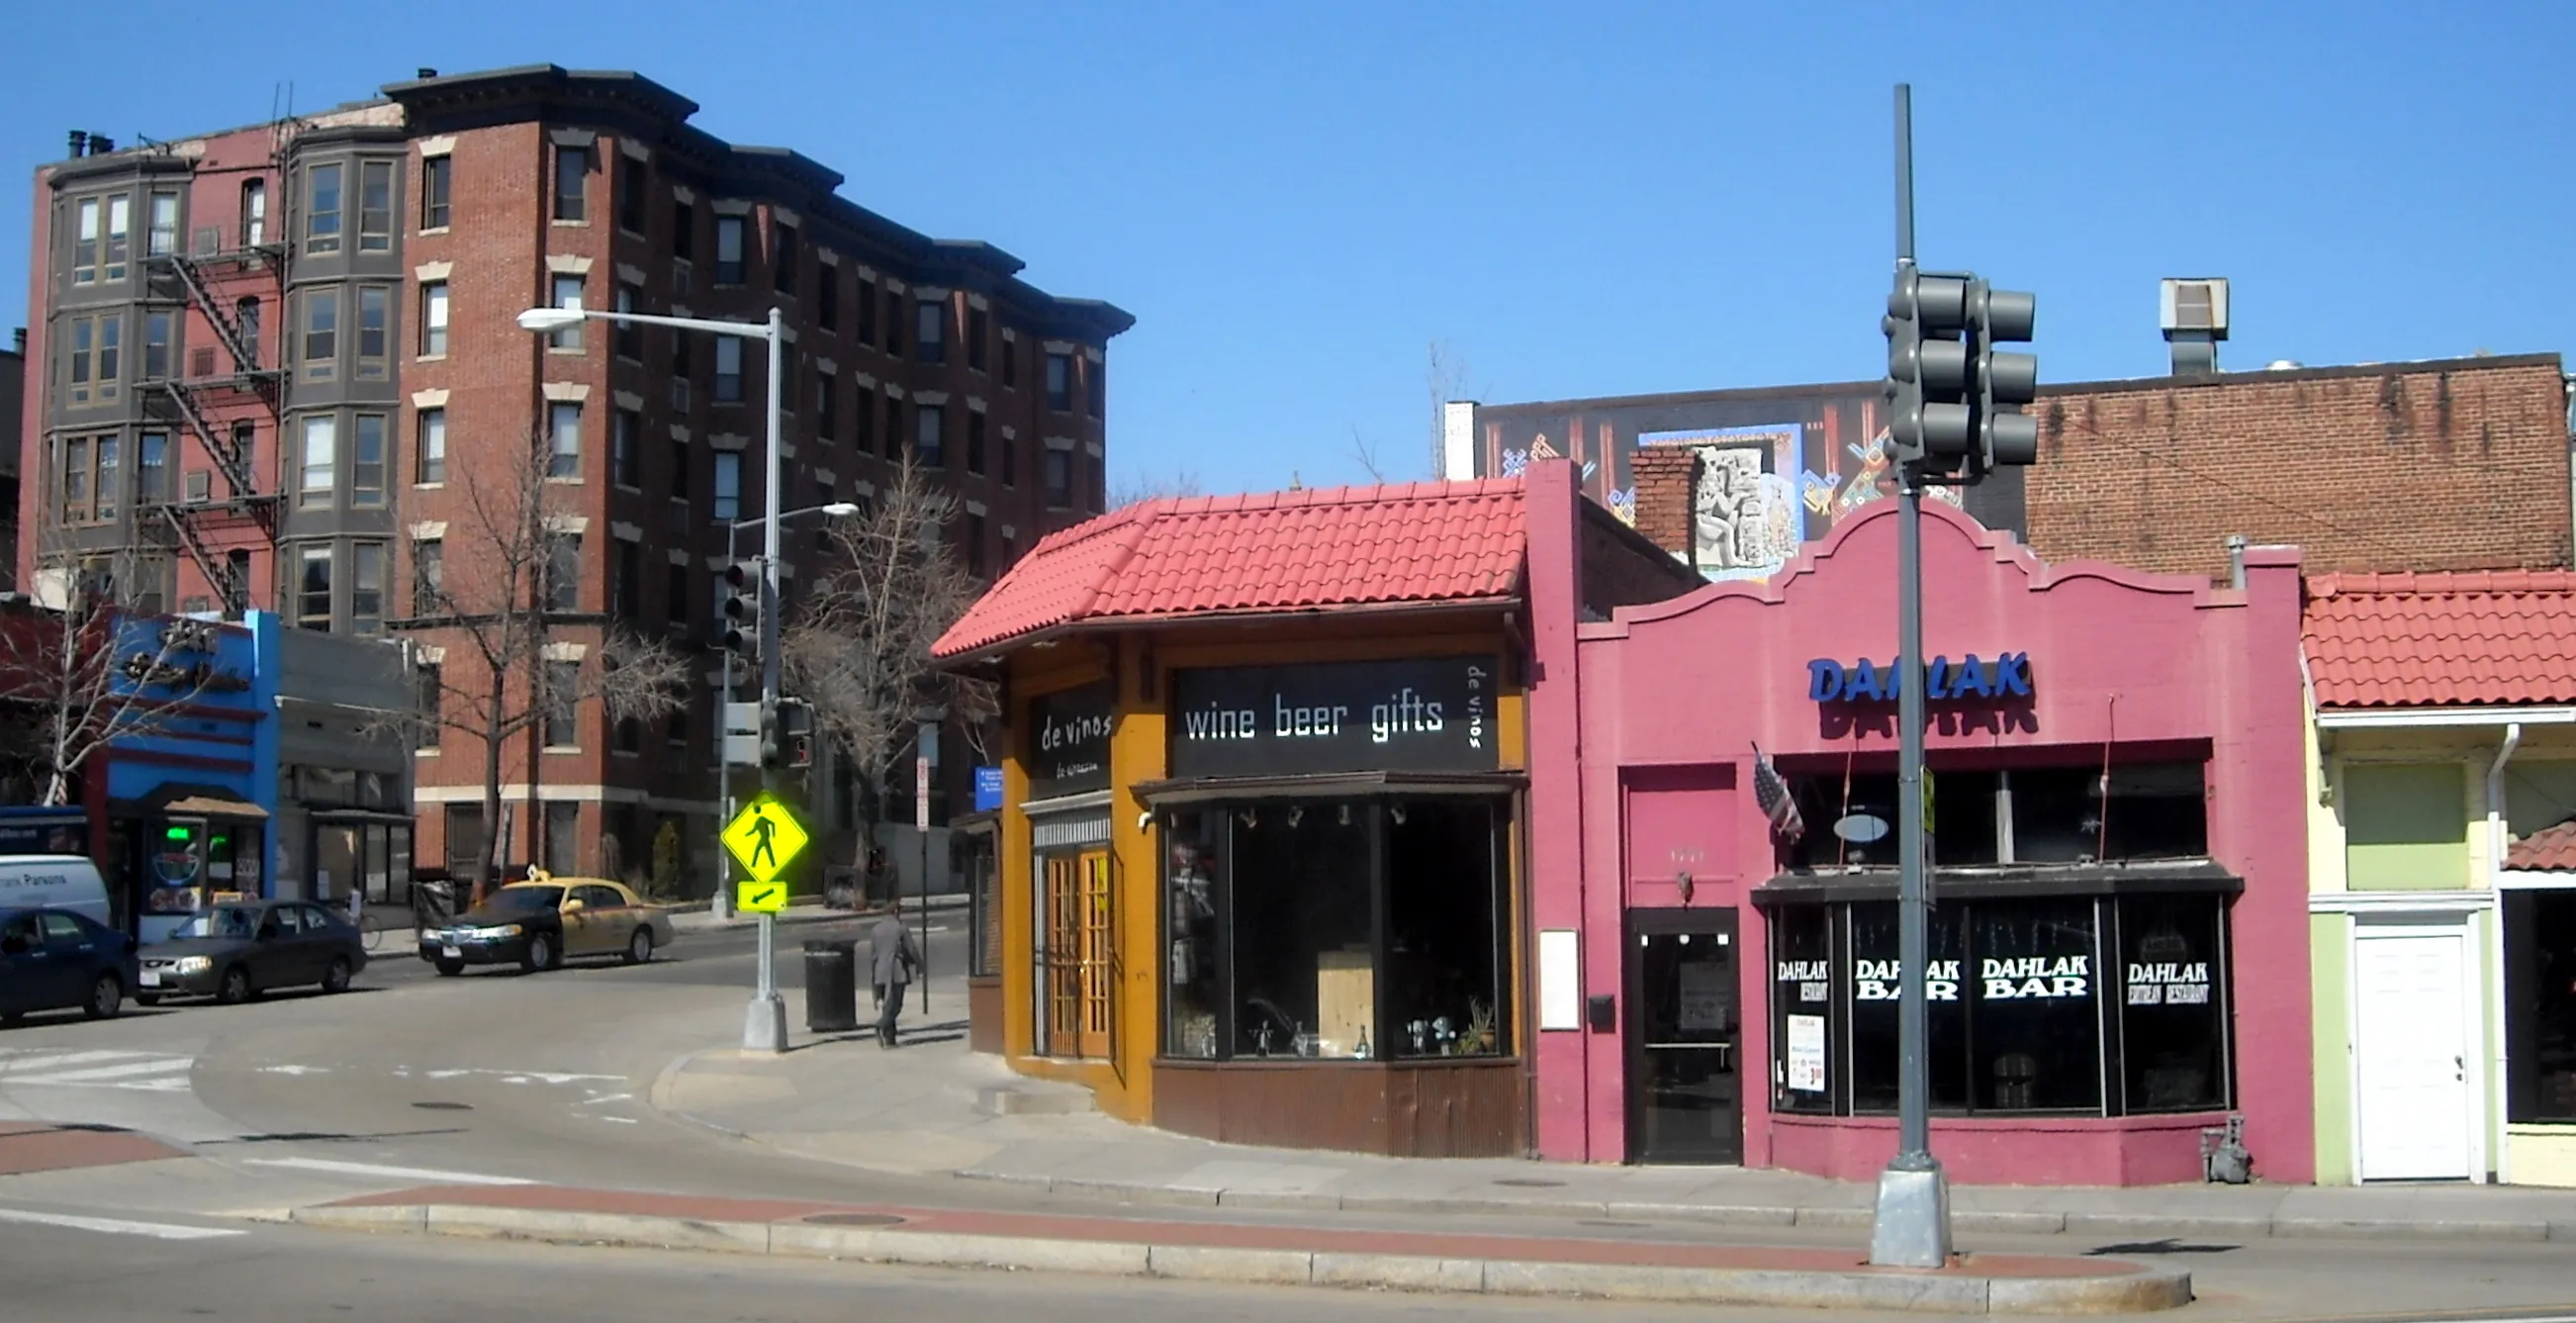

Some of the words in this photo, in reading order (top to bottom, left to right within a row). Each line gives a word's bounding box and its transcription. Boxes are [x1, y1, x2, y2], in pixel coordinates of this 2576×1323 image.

[1467, 666, 1487, 689] de
[1185, 701, 1255, 739] wine
[1275, 693, 1348, 736] beer
[1372, 688, 1443, 743] gifts
[1468, 696, 1484, 748] vinos
[1042, 714, 1061, 750] de
[1065, 715, 1112, 745] vinos
[1778, 960, 1829, 982] DAHLAK
[1981, 955, 2089, 979] DAHLAK
[2128, 962, 2209, 984] DAHLAK
[1982, 977, 2087, 999] BAR
